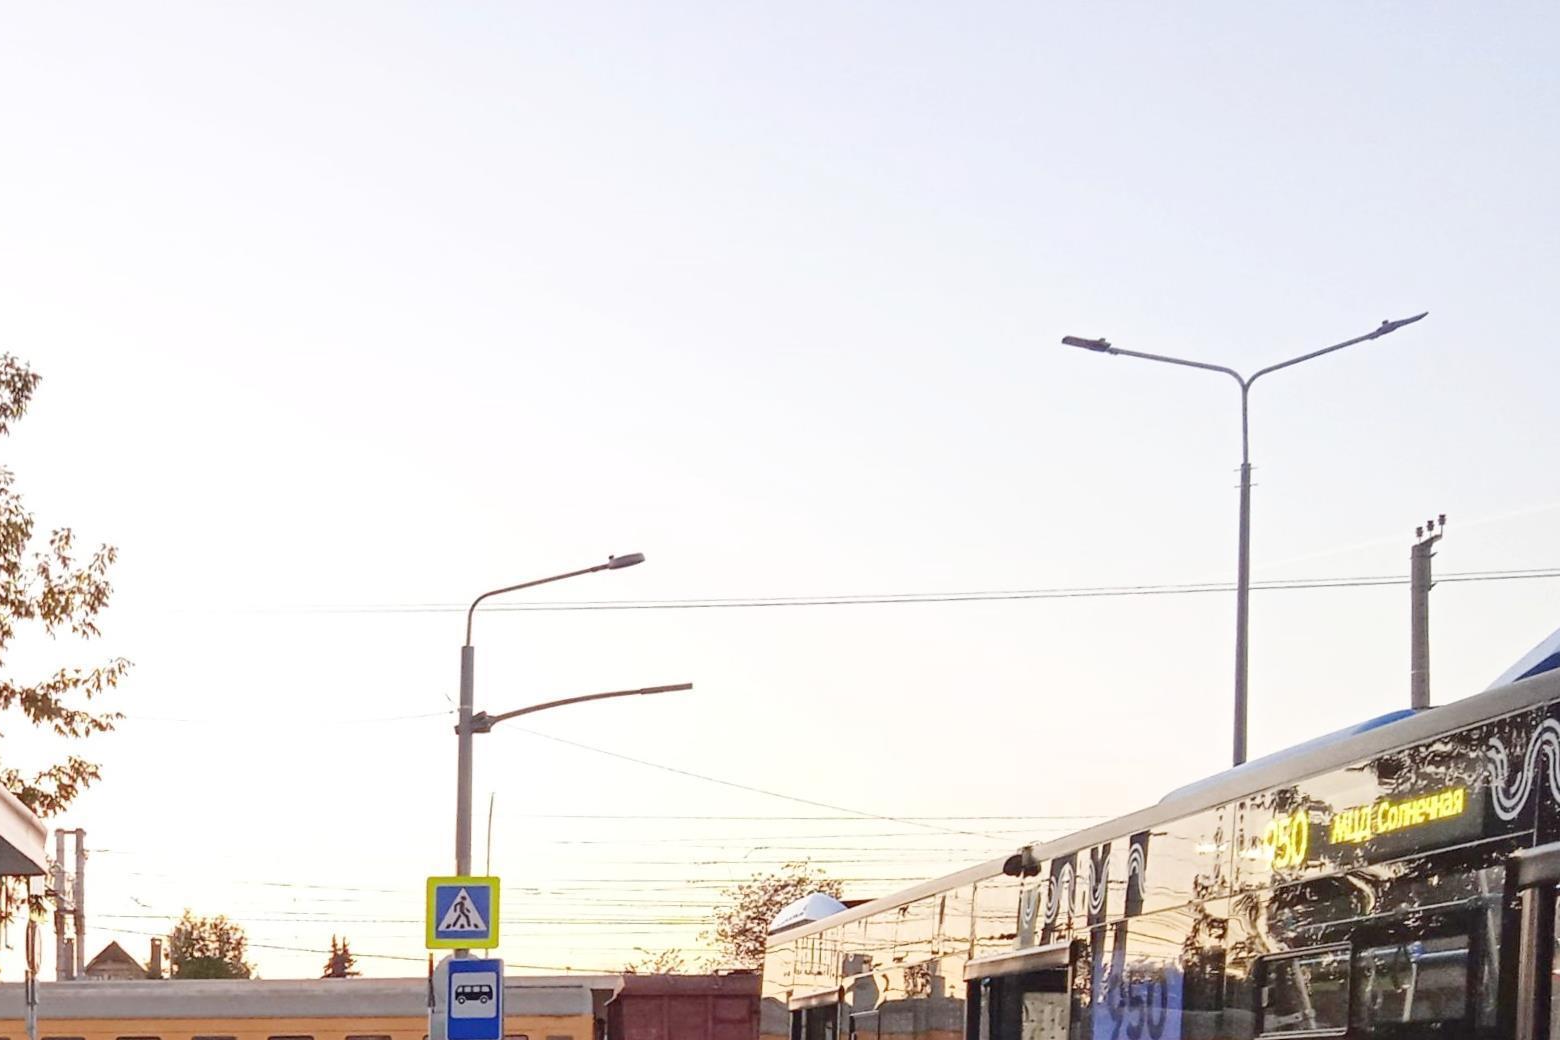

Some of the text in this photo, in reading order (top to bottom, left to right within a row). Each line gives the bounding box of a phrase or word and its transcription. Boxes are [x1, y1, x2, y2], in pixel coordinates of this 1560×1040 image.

[1263, 787, 1466, 868] 950 МЦД Солнечная
